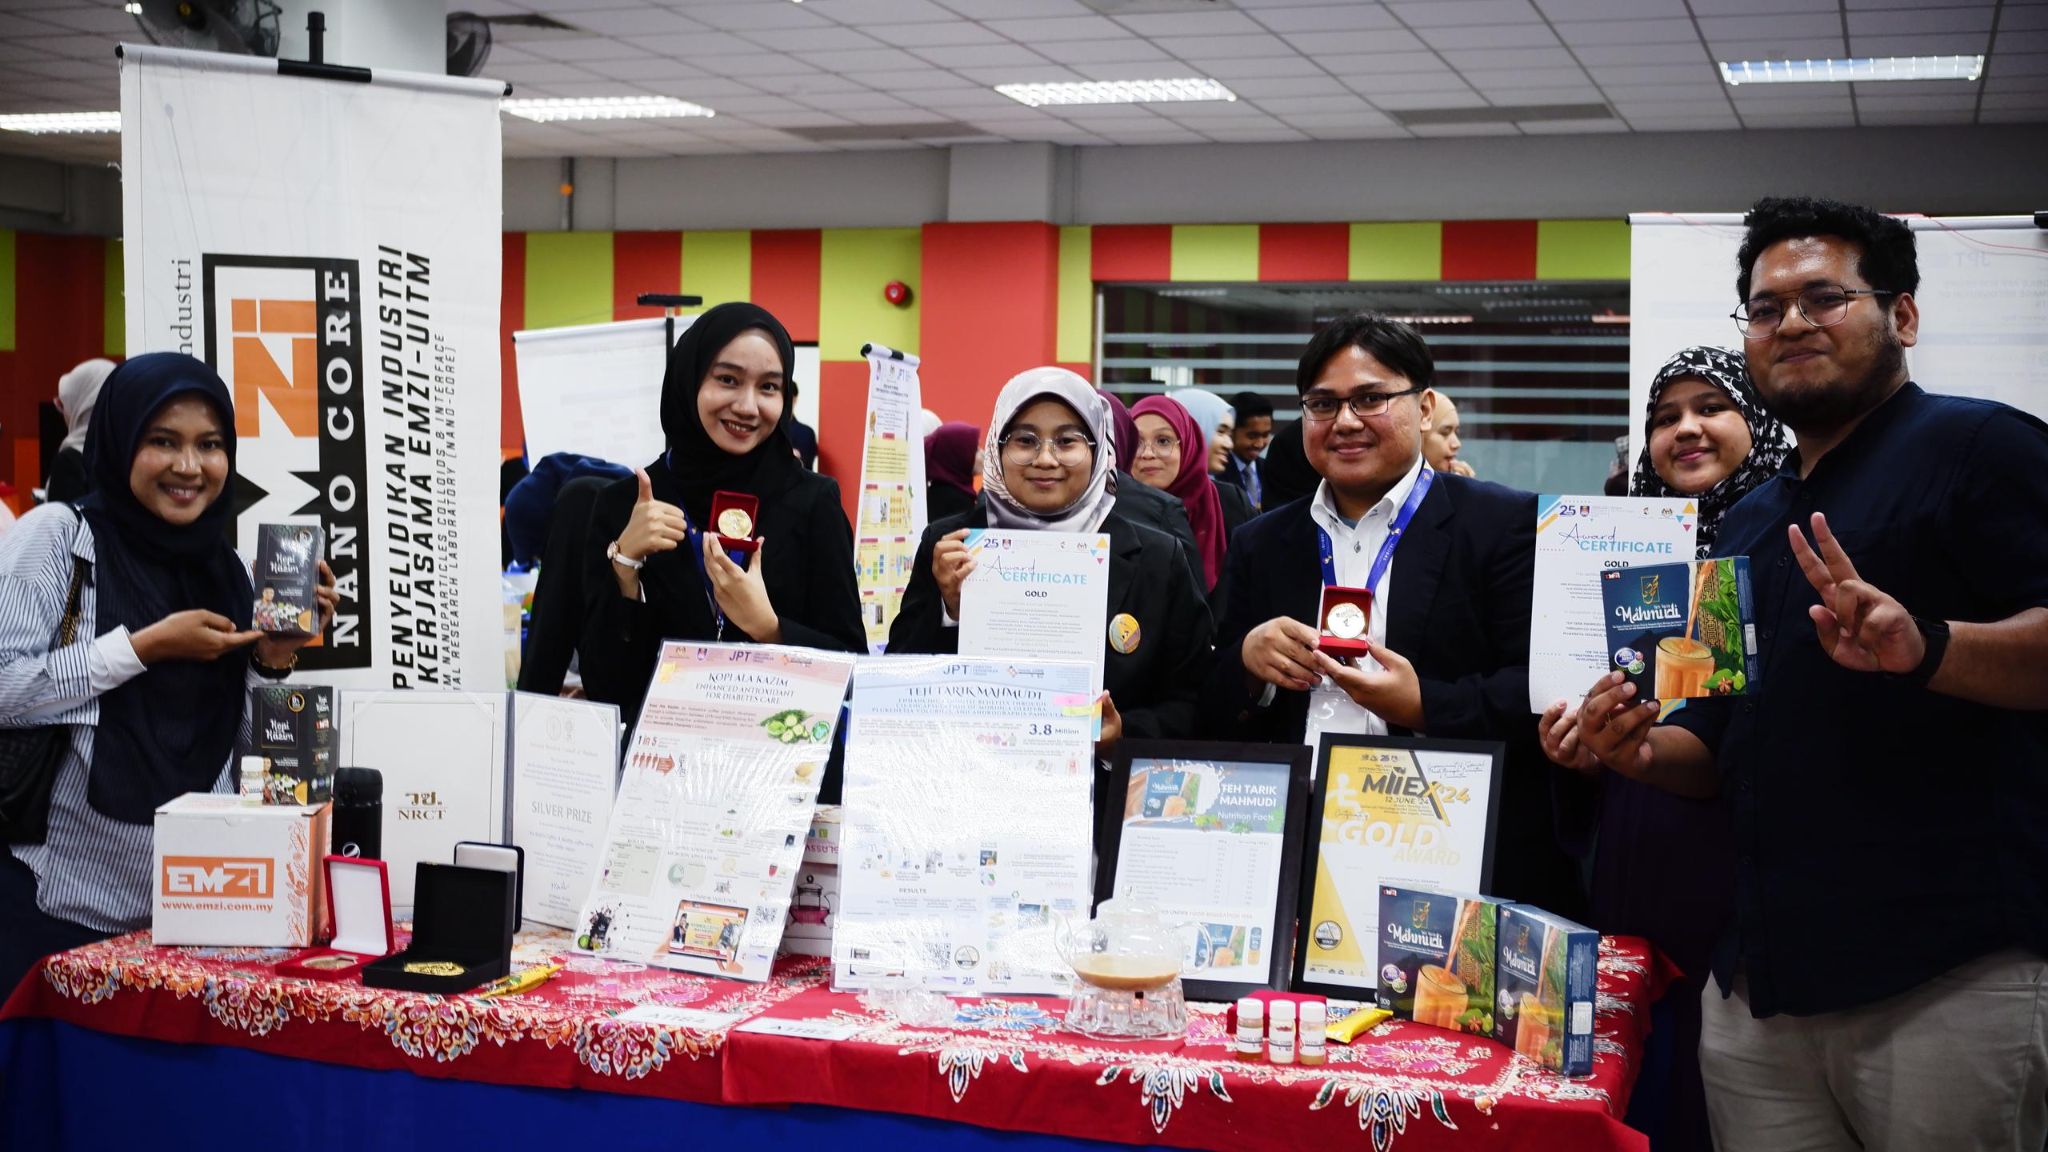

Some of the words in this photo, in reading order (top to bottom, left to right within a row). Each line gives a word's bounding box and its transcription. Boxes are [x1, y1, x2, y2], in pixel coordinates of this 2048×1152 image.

[170, 258, 192, 355] ndustri
[378, 244, 404, 419] INDUSTRI
[324, 271, 355, 441] CORE
[406, 251, 432, 457] EMZI-UITM
[434, 333, 445, 422] INTERFACE
[435, 449, 447, 528] COLLOIDS
[446, 468, 459, 569] LABORATORY
[1560, 505, 1576, 516] 25
[1559, 523, 1616, 545] Award
[984, 538, 999, 549] 25
[1579, 540, 1672, 554] CERTIFICATE
[328, 474, 359, 648] NANO
[384, 433, 414, 690] PENYELIDIKAN
[1604, 560, 1629, 568] GOLD
[409, 474, 439, 684] KERJASAMA
[1002, 571, 1088, 585] CERTIFICATE
[438, 534, 451, 665] NANOPARTICLES
[1025, 590, 1048, 598] GOLD
[449, 577, 461, 660] RESEARCH
[729, 650, 753, 663] JPT
[943, 664, 970, 675] JPT
[708, 672, 734, 683] KOPI
[756, 675, 790, 688] KAZIM
[1029, 723, 1053, 736] 3.8
[1220, 783, 1241, 794] TEH
[1243, 784, 1277, 795] TARIK
[1219, 796, 1277, 807] MAHMUDI
[1394, 796, 1416, 804] JUNE
[398, 809, 447, 820] NRCT
[531, 800, 564, 819] SILVER
[566, 807, 593, 825] PRIZE
[1218, 812, 1251, 820] Nutrition
[1252, 813, 1274, 821] Facts
[1337, 820, 1441, 850] GOLD
[1393, 850, 1462, 866] AWARD
[161, 901, 273, 913] www.emzi.com.my
